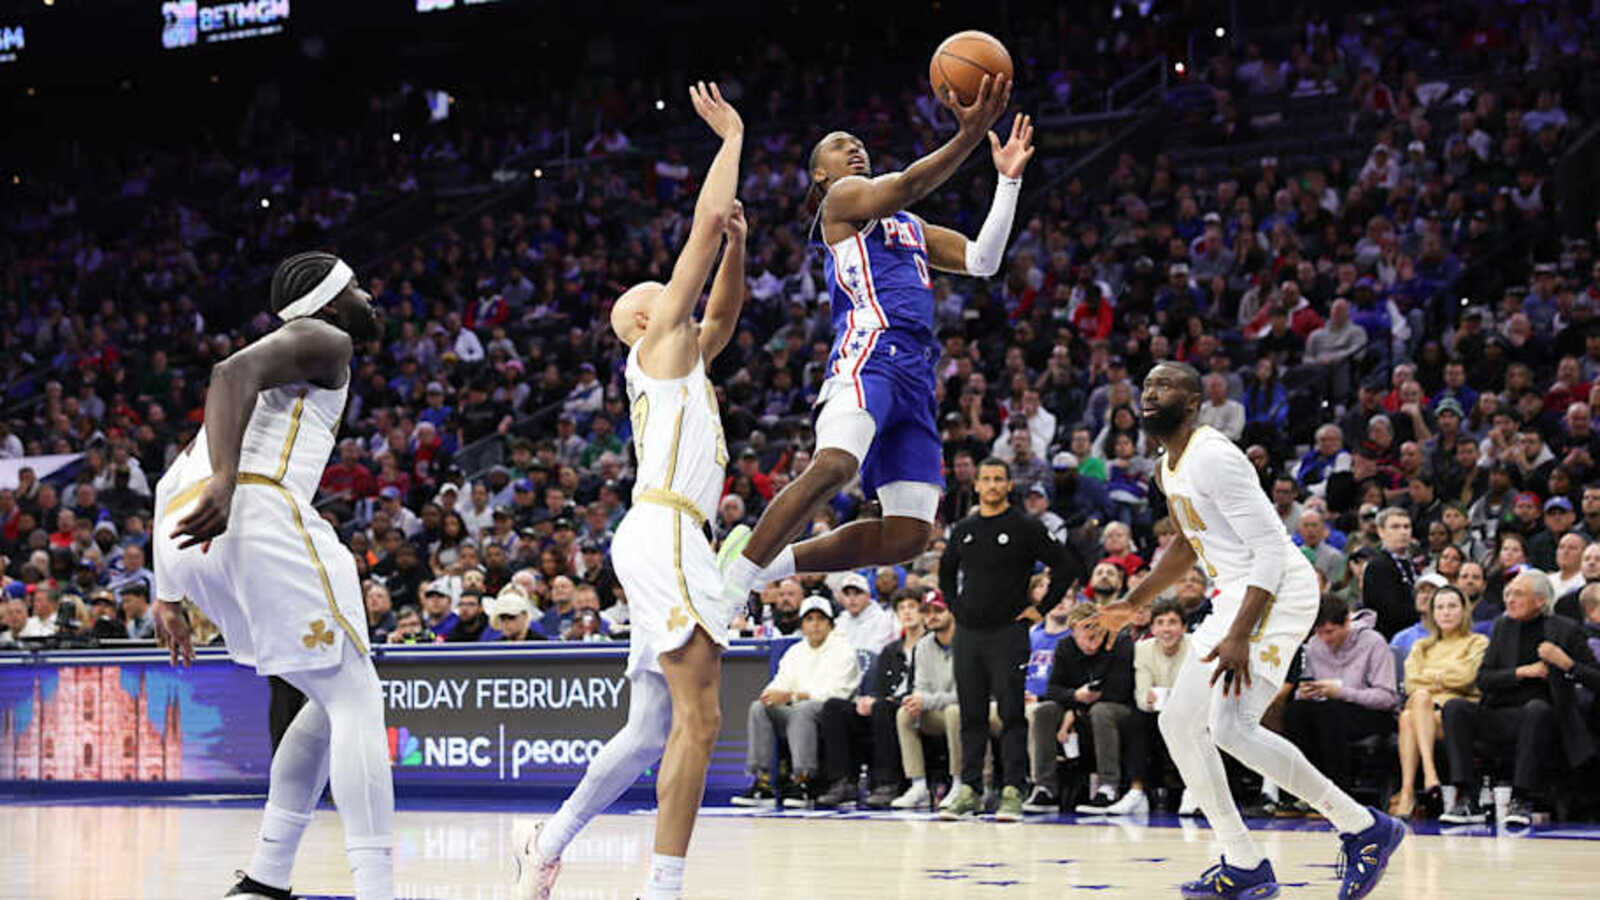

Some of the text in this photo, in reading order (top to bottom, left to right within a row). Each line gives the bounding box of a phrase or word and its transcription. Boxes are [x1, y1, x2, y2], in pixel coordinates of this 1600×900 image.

[476, 678, 625, 708] FEBRUARY
[424, 736, 604, 779] NBC peaco
